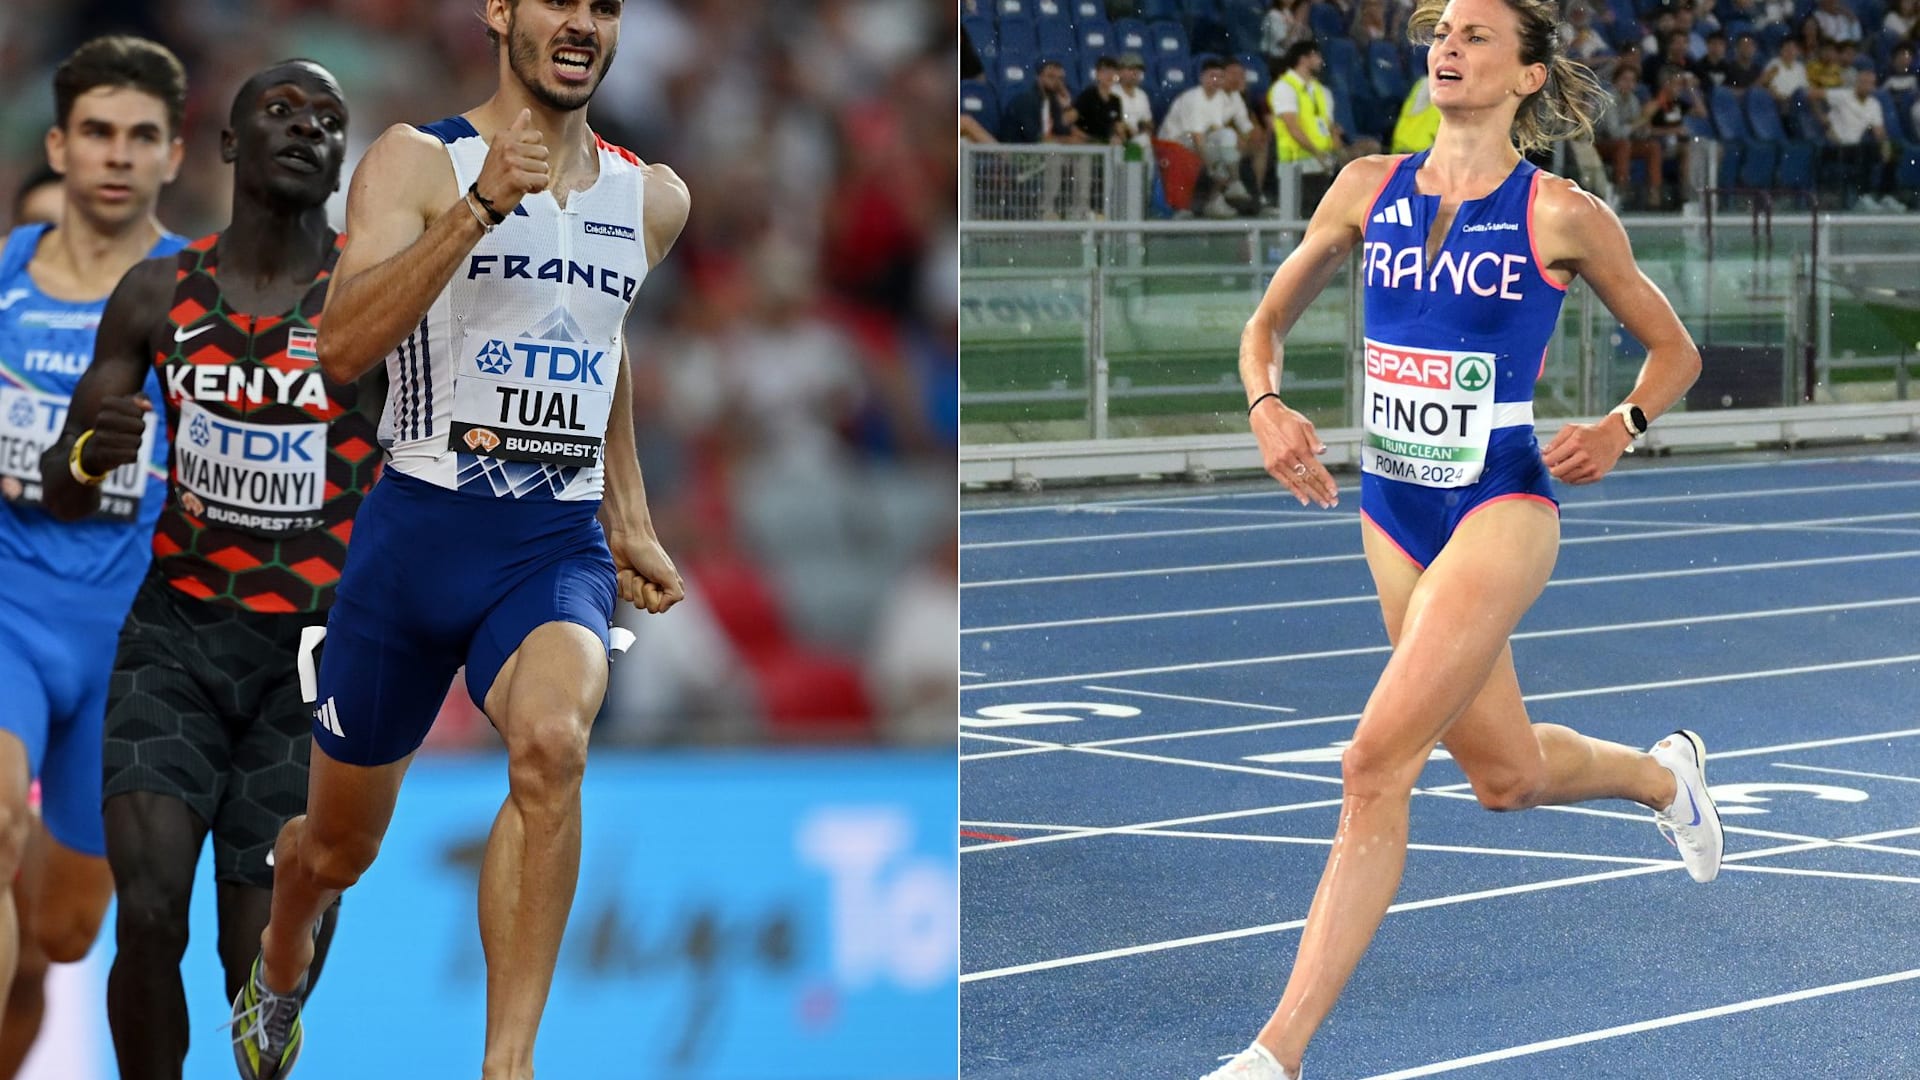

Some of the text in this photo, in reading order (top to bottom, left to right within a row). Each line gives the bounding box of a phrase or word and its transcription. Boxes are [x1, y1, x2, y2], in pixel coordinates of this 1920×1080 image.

[24, 349, 91, 374] ITALI
[514, 344, 605, 386] TDK
[1367, 348, 1450, 386] SPAR
[166, 364, 328, 411] KENYA
[496, 386, 586, 431] TUAL
[1373, 391, 1477, 437] FINOT
[211, 420, 315, 462] TDK
[505, 436, 592, 458] BUDAPEST
[1386, 440, 1407, 455] RUN
[180, 448, 316, 506] WANYONYI
[1376, 455, 1464, 483] ROMA 2024
[206, 505, 294, 531] BUDAPEST
